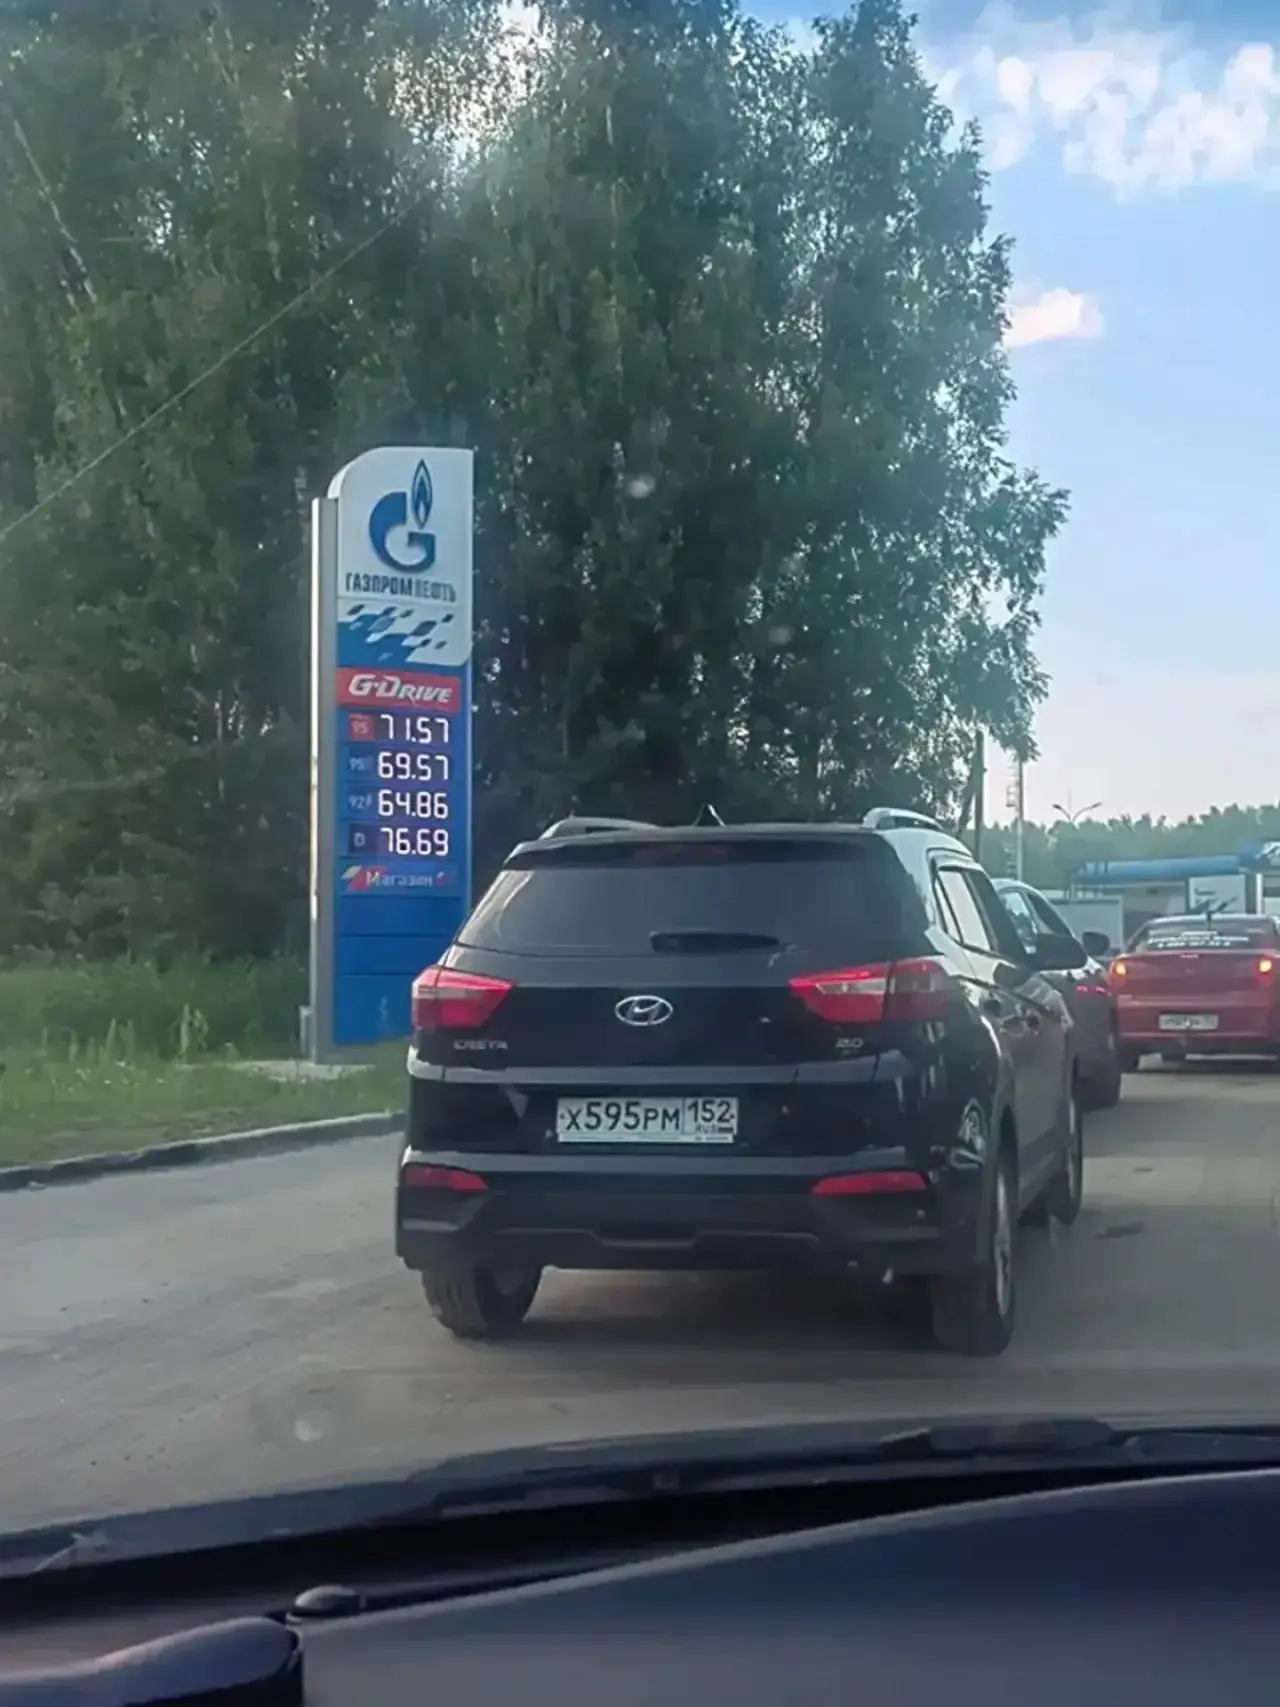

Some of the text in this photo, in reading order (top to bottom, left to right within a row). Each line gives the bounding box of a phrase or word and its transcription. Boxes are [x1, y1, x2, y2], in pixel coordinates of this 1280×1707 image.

[380, 713, 449, 743] 71.57
[378, 751, 449, 781] 69.57
[378, 789, 448, 819] 64.86
[380, 827, 449, 856] 76.69
[688, 1100, 731, 1123] 152
